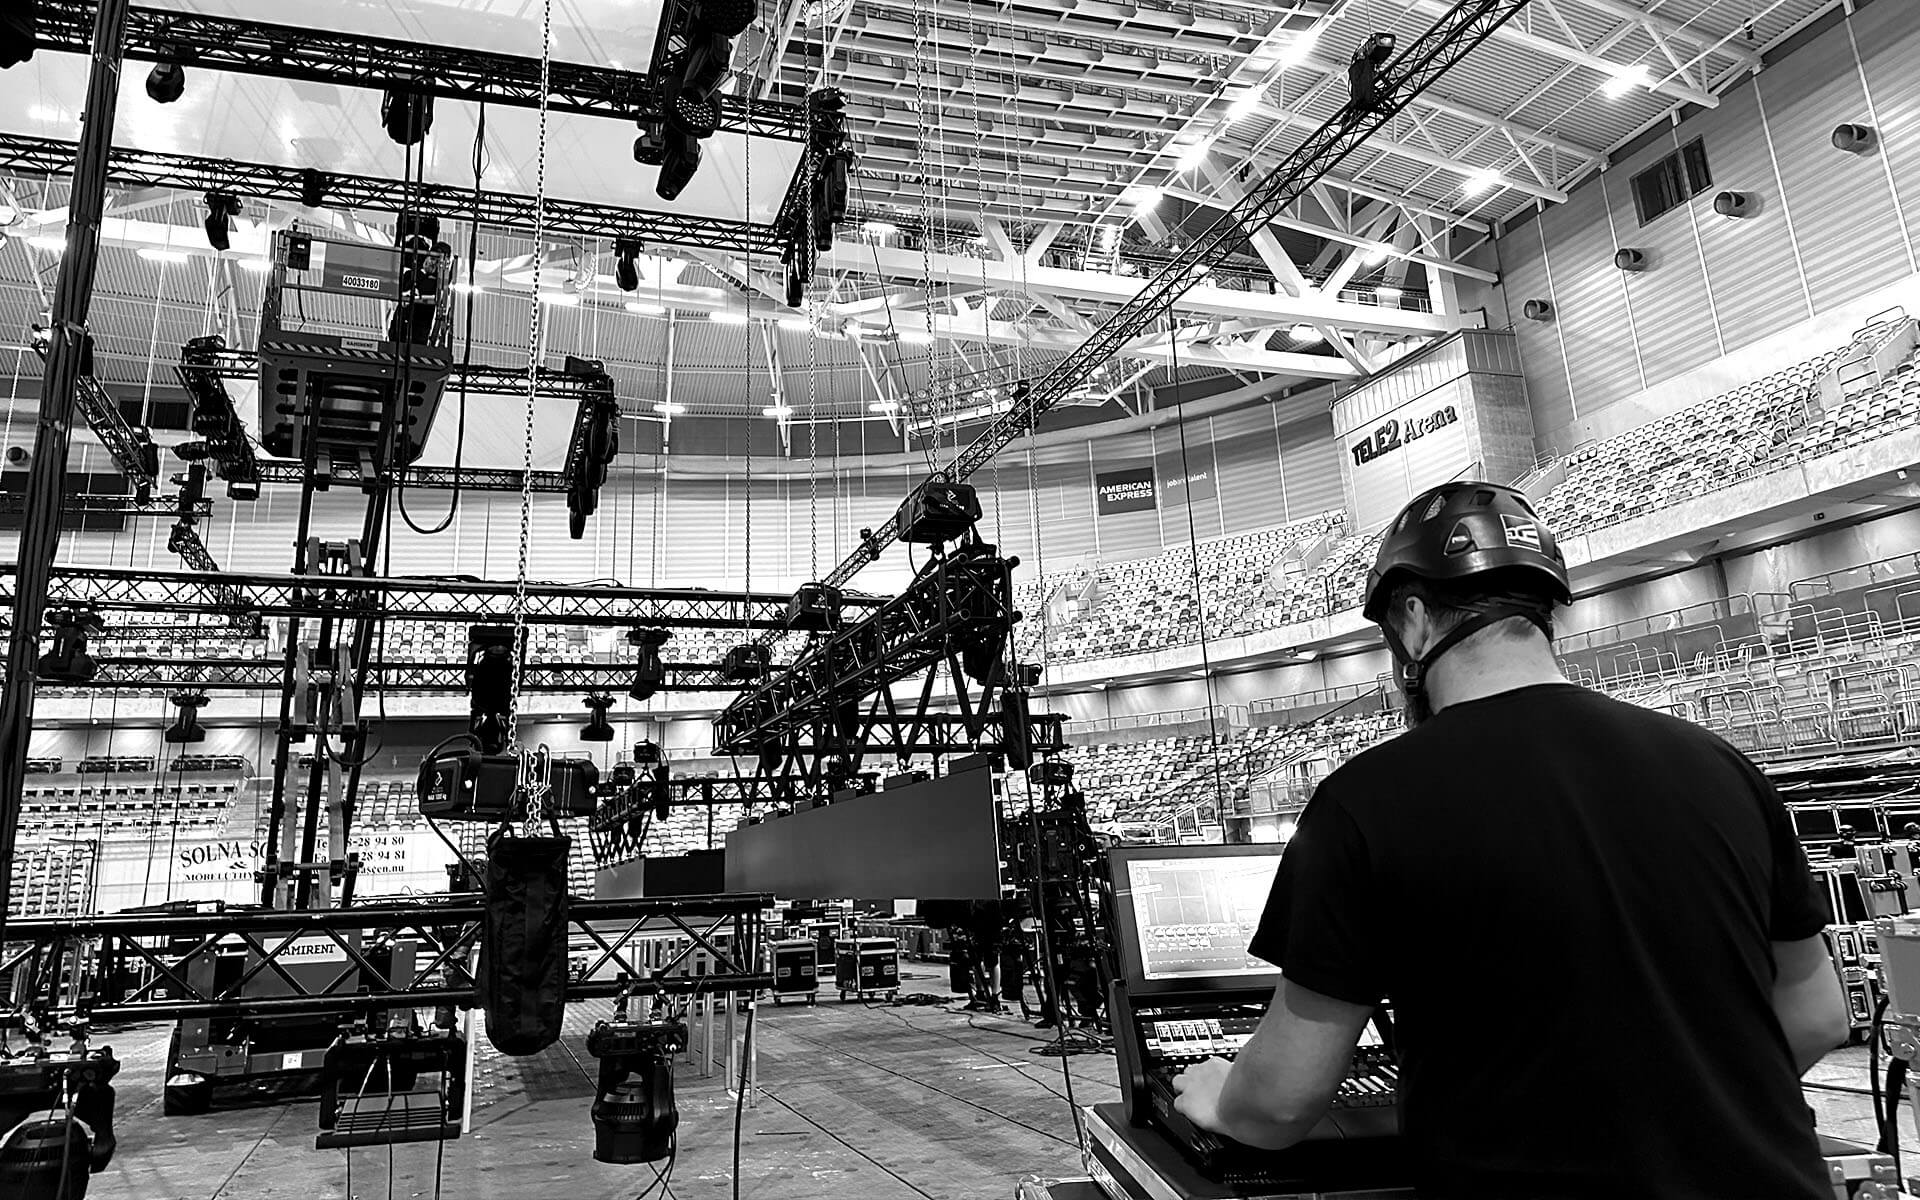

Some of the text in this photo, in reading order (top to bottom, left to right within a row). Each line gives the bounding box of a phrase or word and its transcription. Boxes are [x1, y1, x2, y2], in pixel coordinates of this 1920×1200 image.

[343, 276, 379, 289] 40033180
[1351, 405, 1458, 466] TELE2 Arena
[1099, 481, 1152, 494] AMERICAN
[1107, 489, 1153, 502] EXPRESS
[391, 835, 404, 845] 80
[180, 841, 242, 868] SOLNA
[280, 944, 336, 956] AMIRENT
